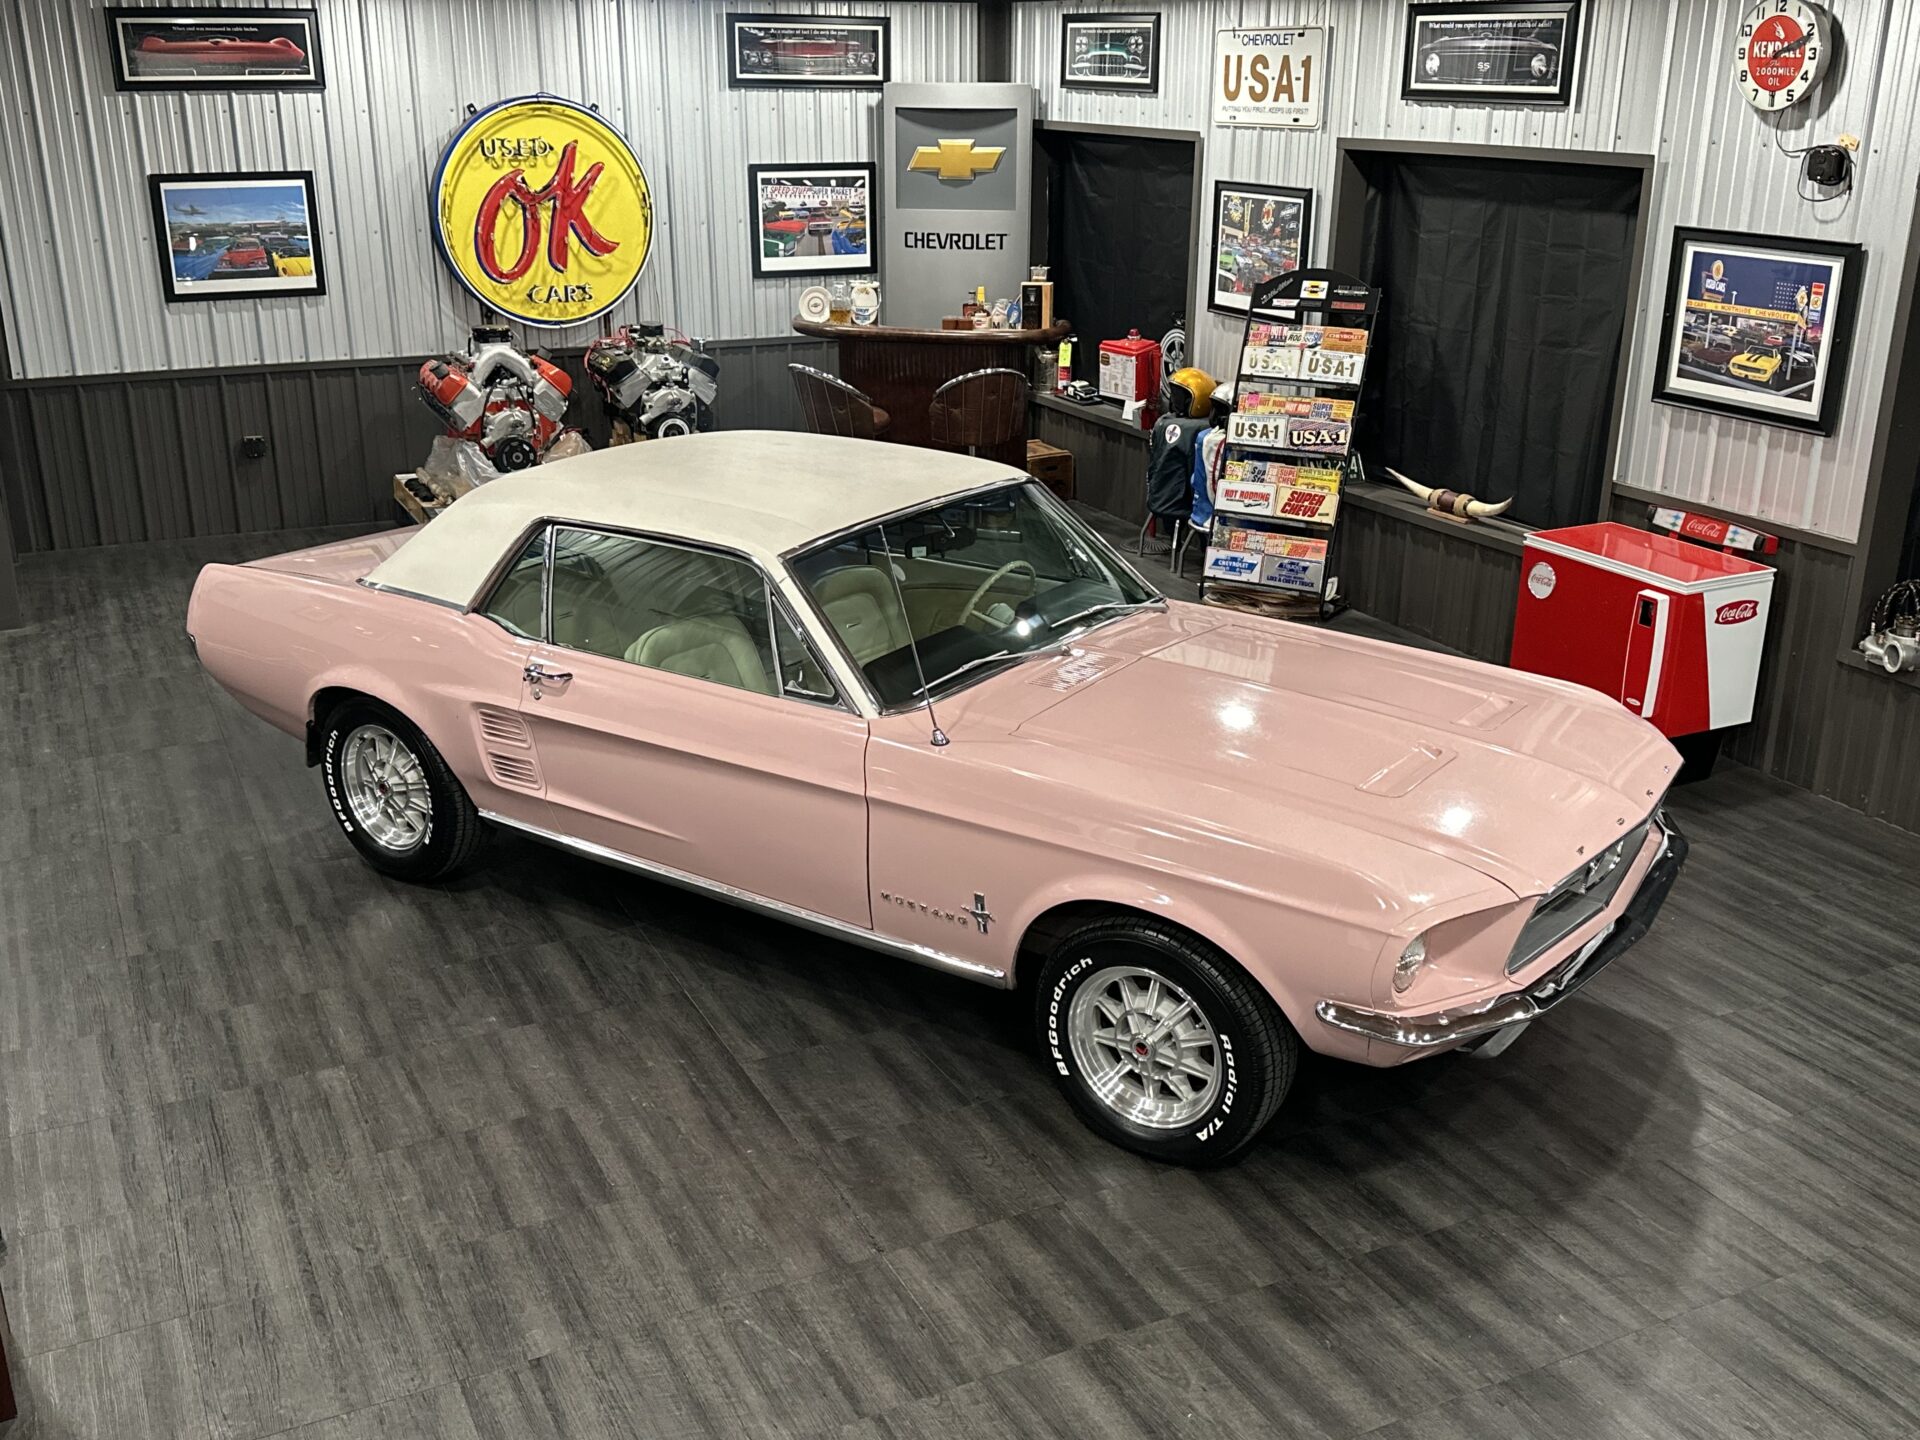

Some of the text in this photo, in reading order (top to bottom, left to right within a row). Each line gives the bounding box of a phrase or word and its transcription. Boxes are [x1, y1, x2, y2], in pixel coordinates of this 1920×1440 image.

[1757, 7, 1765, 19] 11
[1741, 25, 1753, 37] 10
[1807, 23, 1815, 36] 2
[1241, 33, 1296, 46] CHEVROLET
[1738, 48, 1746, 60] 9
[1808, 48, 1817, 60] 3
[1740, 70, 1748, 82] 8
[1768, 78, 1780, 86] OIL
[1800, 70, 1809, 83] 4
[1752, 89, 1759, 101] 7
[1786, 89, 1795, 102] 5
[479, 136, 552, 158] USED
[474, 139, 621, 285] OK
[904, 231, 1008, 250] CHEVROLET
[527, 284, 594, 304] CARS
[1756, 309, 1791, 320] CHEVROLET
[1312, 403, 1333, 411] SUPER
[1224, 489, 1271, 502] HOT RODDING
[1287, 490, 1326, 507] SUPER
[1280, 502, 1320, 518] CHEVY
[1218, 559, 1249, 568] CHEVROLET
[880, 890, 968, 925] MUSTANG
[1048, 957, 1093, 1076] BFGoodrich
[1219, 1033, 1238, 1115] Radial
